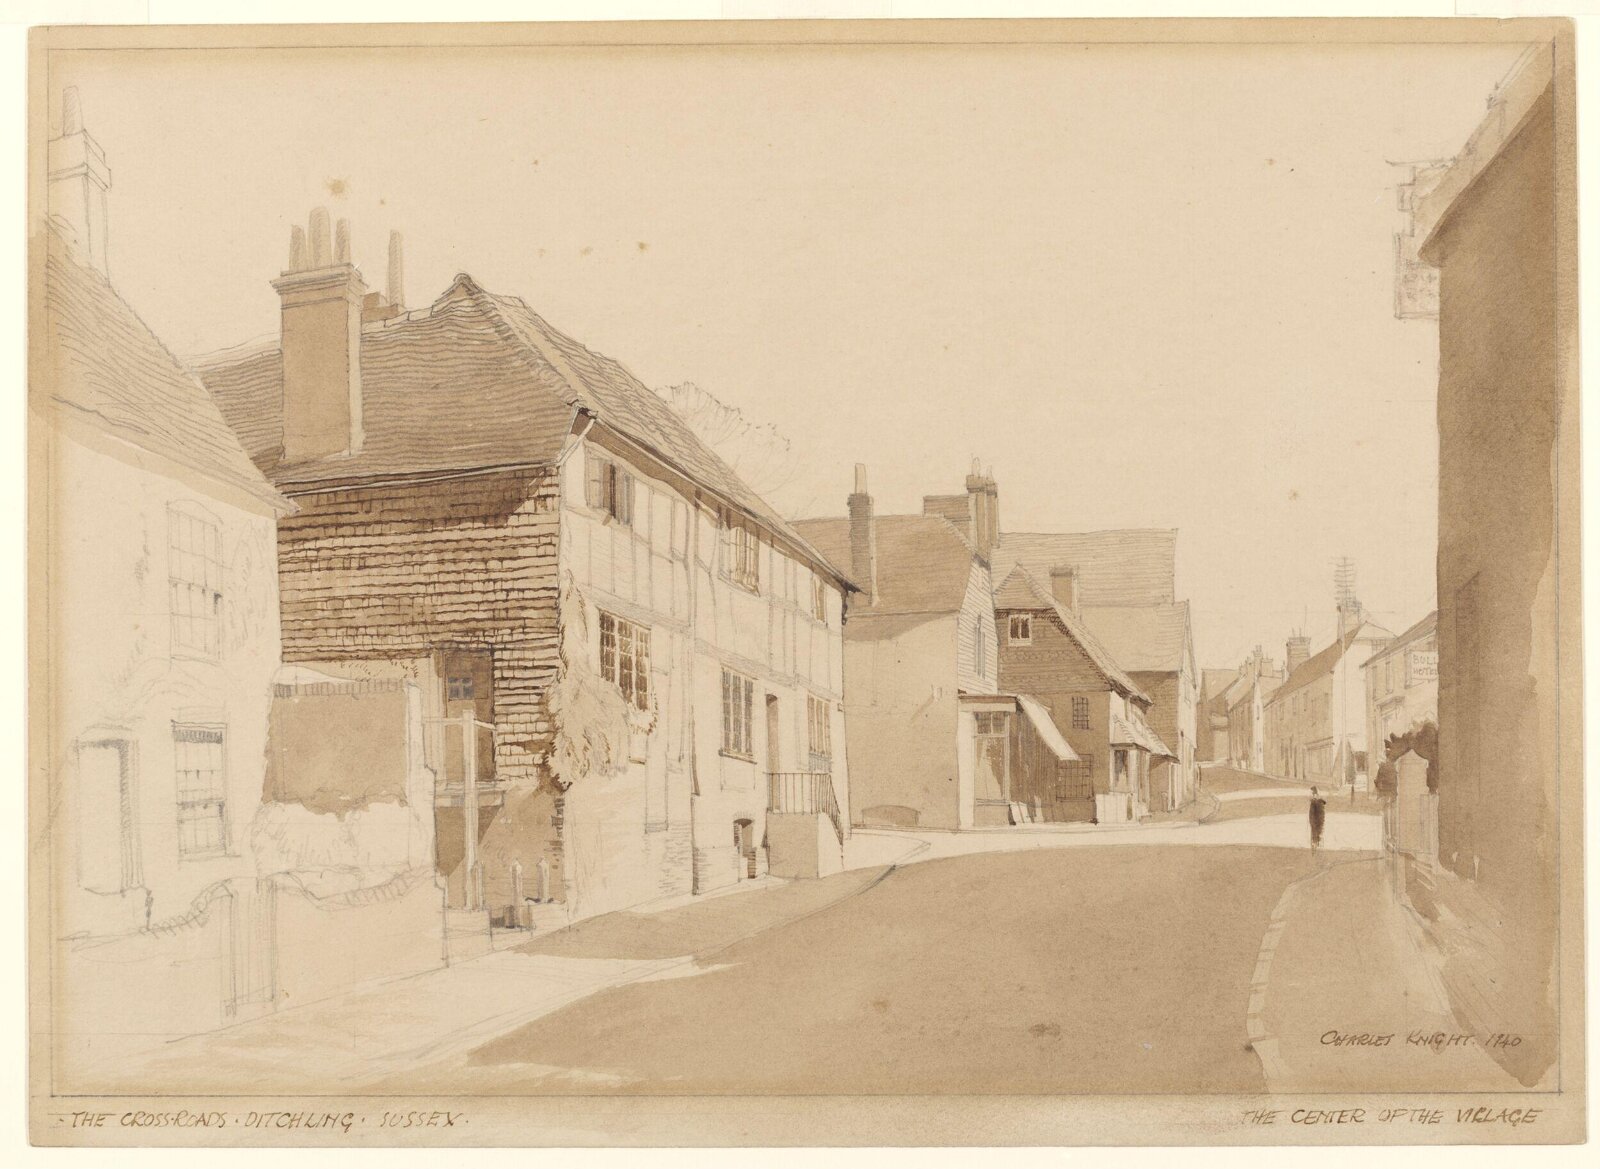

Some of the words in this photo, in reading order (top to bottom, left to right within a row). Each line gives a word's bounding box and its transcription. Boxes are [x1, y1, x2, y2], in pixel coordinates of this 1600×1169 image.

[1320, 1030, 1395, 1047] CHARLES
[1485, 1033, 1522, 1048] 1940
[70, 1112, 110, 1128] THE
[245, 1111, 353, 1133] DITCHLING
[380, 1111, 461, 1128] SUSSEX
[1240, 1110, 1281, 1125] THE
[1291, 1109, 1366, 1125] CENTER
[1408, 1109, 1443, 1125] THE
[1456, 1107, 1543, 1126] VILLAGE
